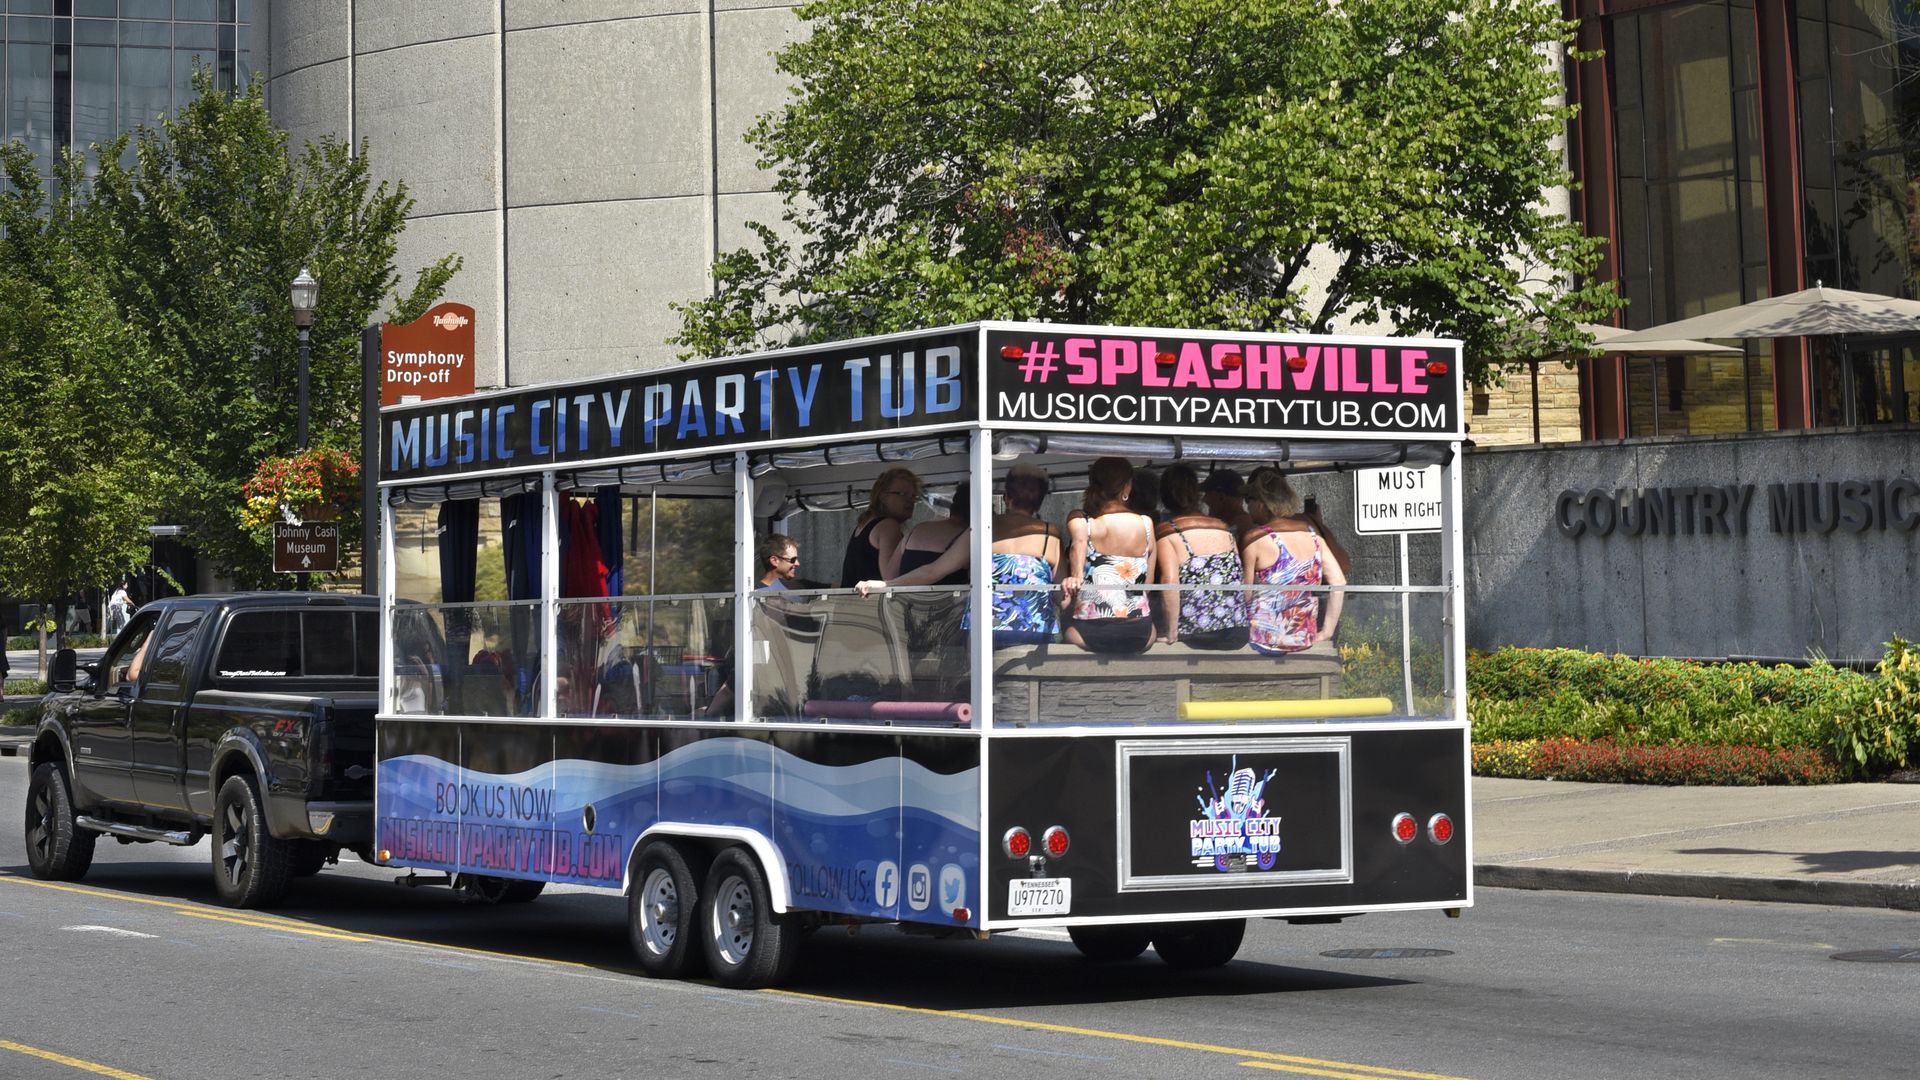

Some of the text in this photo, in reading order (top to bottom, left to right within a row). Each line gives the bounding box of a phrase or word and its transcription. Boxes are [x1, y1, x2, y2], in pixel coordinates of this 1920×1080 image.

[387, 350, 464, 368] Symphony
[1018, 338, 1429, 394] #SPLASHVILLE
[387, 368, 450, 385] Drop-off
[391, 345, 961, 471] MUSIC CITY PARTY TUB
[998, 391, 1446, 428] MUSICCITYPARTYTUB.COM
[1378, 470, 1426, 490] MUST
[1362, 501, 1442, 519] TURN RIGHT
[1555, 478, 1920, 537] COUNTRY MUSIC
[276, 525, 336, 541] Johnny Cash
[286, 541, 326, 554] Museum
[436, 782, 552, 823] BOOK US NOW
[1189, 817, 1281, 838] MUSIC CITY
[380, 816, 623, 881] MUSICCITYPARTYTUB.COM
[1191, 835, 1281, 856] PARTY TUB
[1014, 889, 1064, 906] U977270
